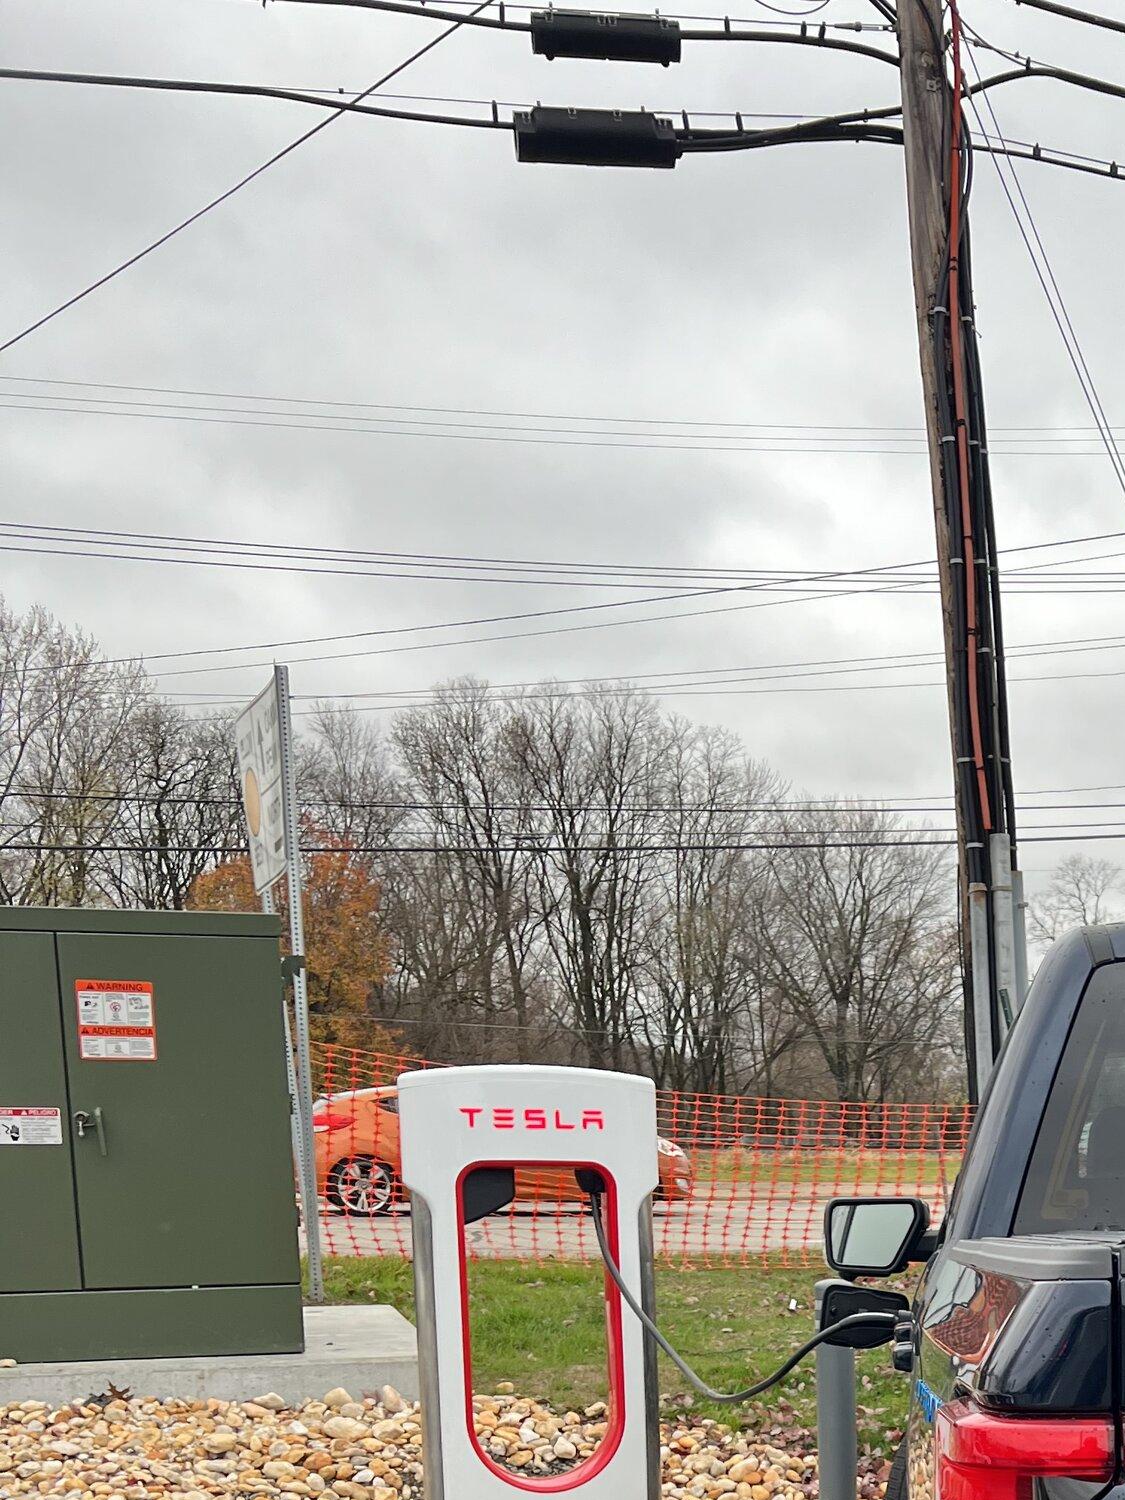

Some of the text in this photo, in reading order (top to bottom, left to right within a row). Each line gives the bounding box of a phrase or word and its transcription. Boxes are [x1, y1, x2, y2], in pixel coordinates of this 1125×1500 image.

[96, 982, 143, 992] WARNING
[92, 1026, 153, 1036] ADVERTENCIA
[459, 1107, 604, 1130] TESLA
